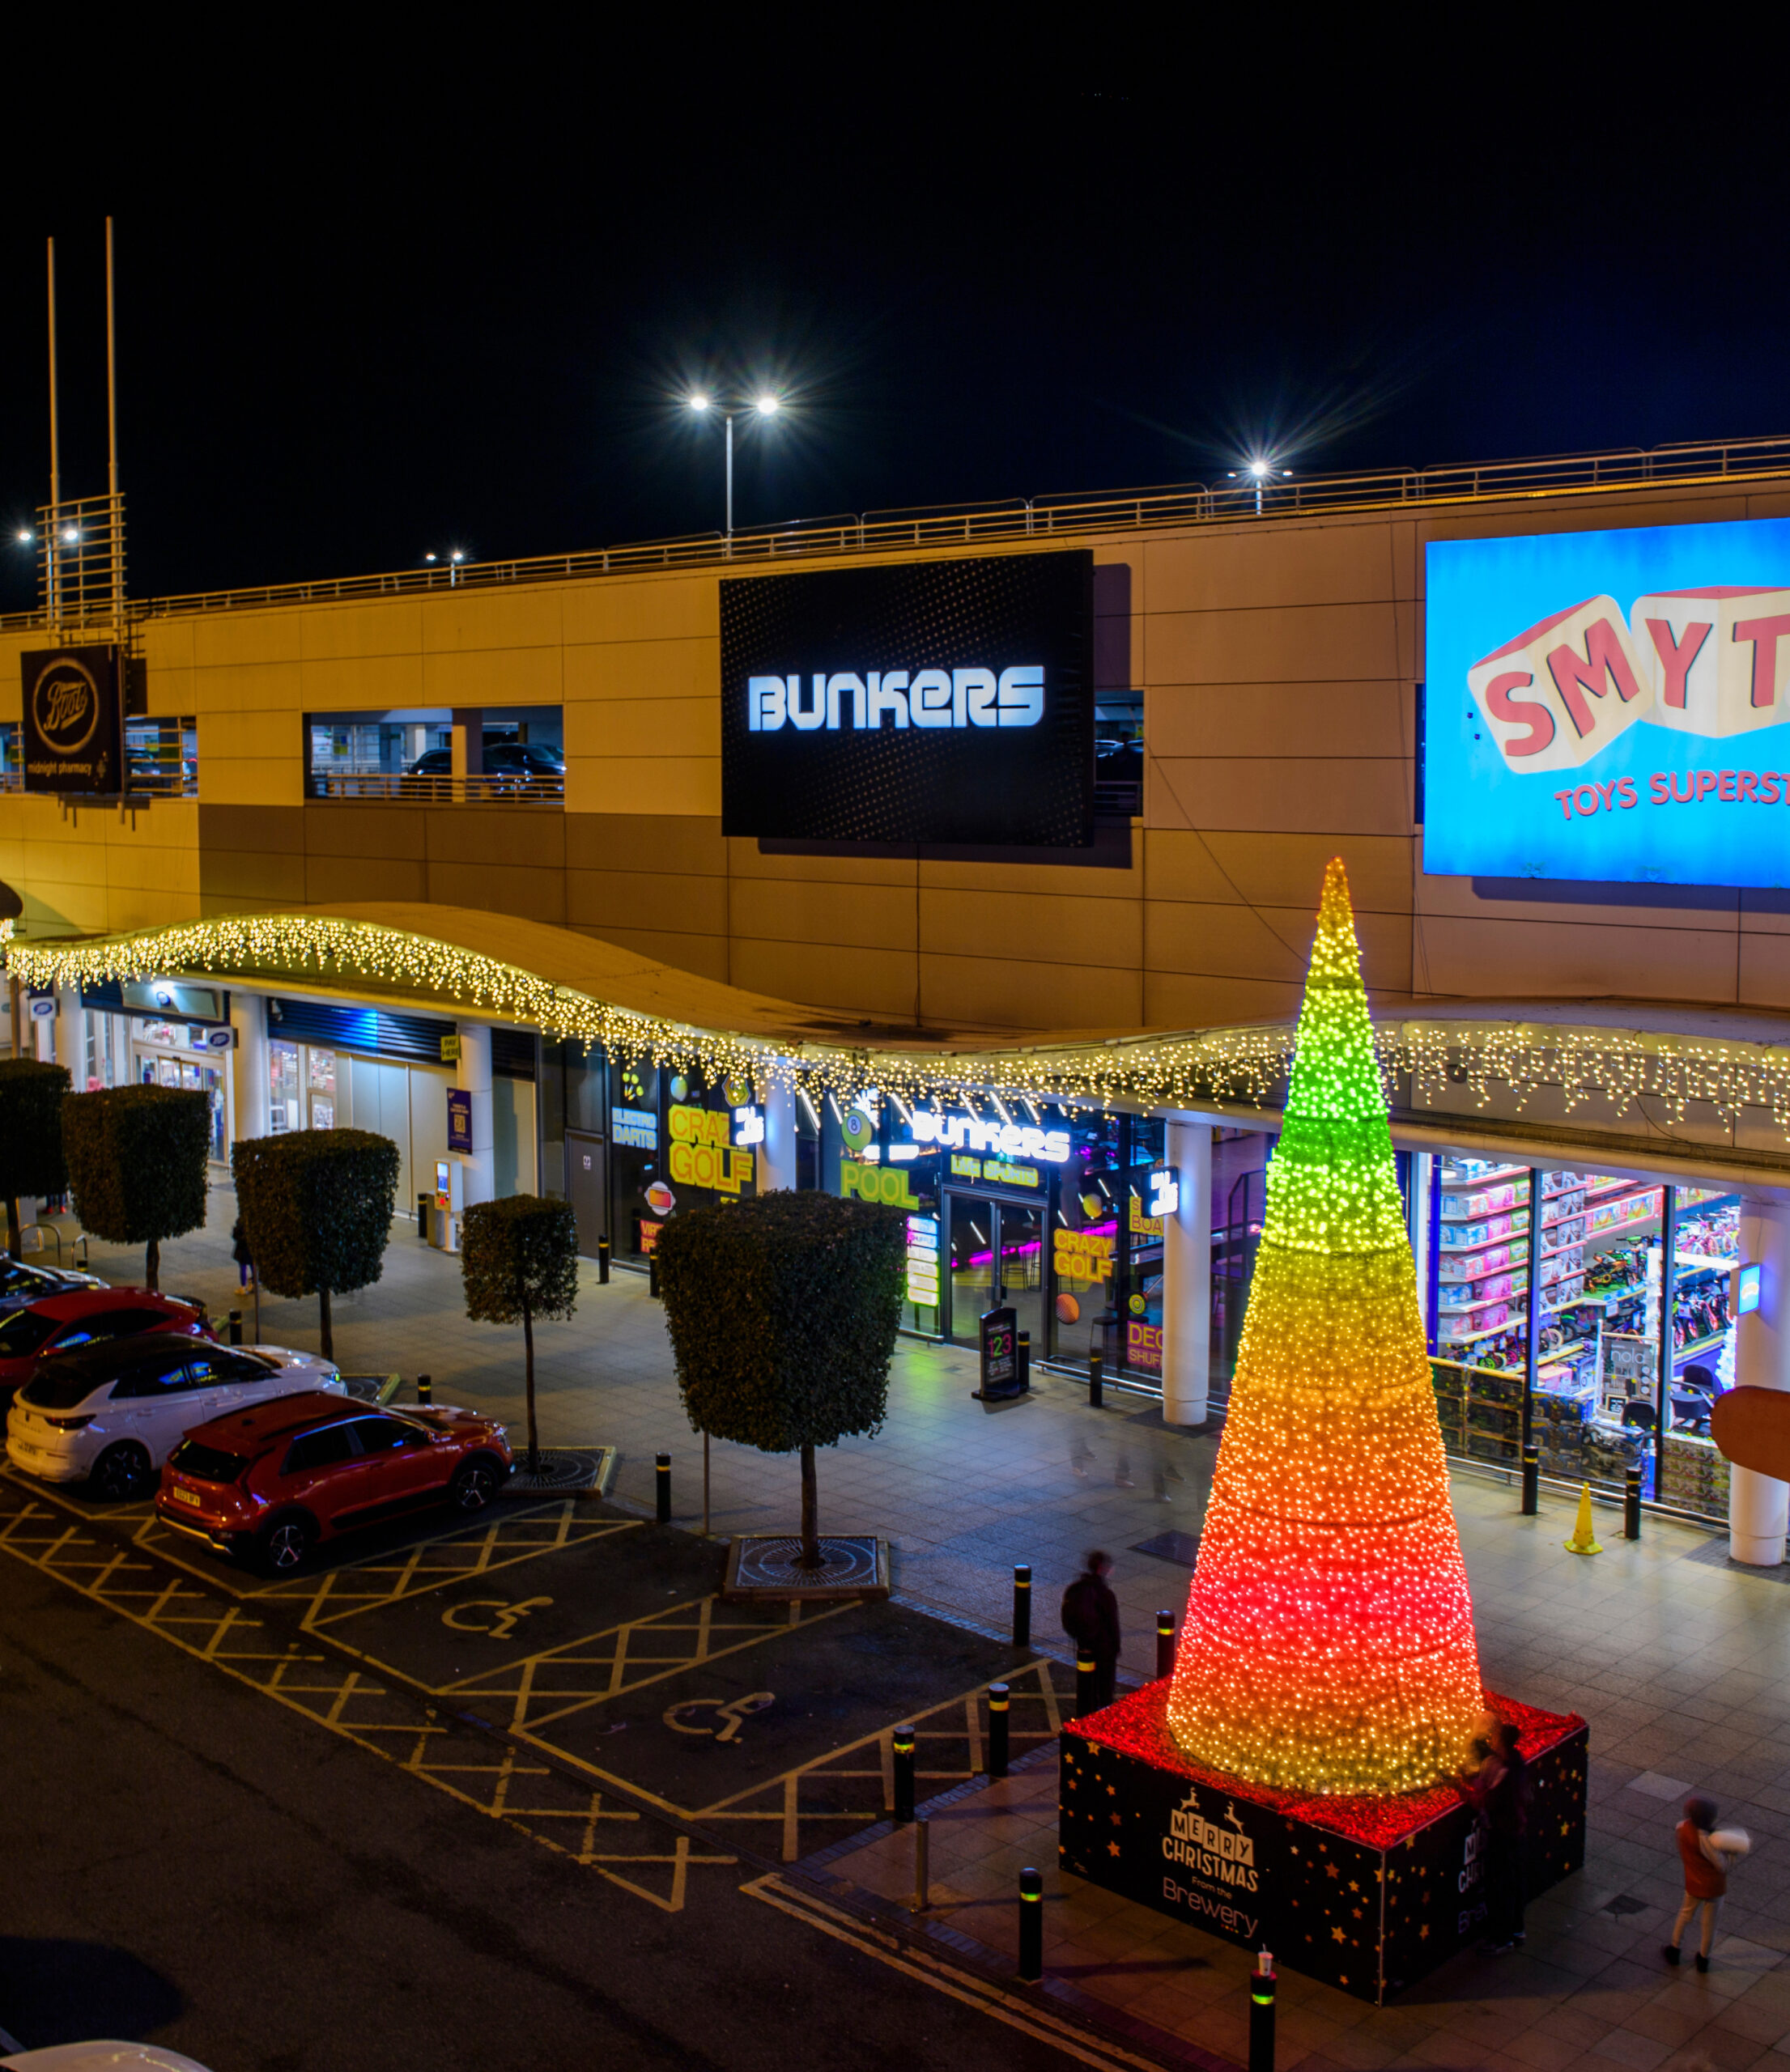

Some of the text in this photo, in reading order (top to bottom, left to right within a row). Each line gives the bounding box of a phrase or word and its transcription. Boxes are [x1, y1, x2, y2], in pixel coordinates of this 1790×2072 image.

[1485, 613, 1790, 758] SMYT
[43, 681, 88, 731] Boots
[28, 761, 91, 777] midnight pharmacy
[1554, 776, 1638, 820] TOYS
[442, 1048, 459, 1057] HERE
[444, 1038, 457, 1047] PAY
[613, 1109, 657, 1128] ELECTRO
[672, 1110, 729, 1145] CRAZ
[614, 1125, 657, 1149] DARTS
[673, 1144, 750, 1189] GOLF
[953, 1157, 1037, 1185] LIVE SPORTS
[844, 1165, 916, 1206] POOL
[1055, 1231, 1112, 1255] CRAZY
[1055, 1252, 1112, 1281] GOLF
[988, 1333, 1012, 1358] 123
[1610, 1347, 1645, 1364] nola
[1173, 1813, 1251, 1860] MERRY
[1162, 1836, 1259, 1892] CHRISTMAS
[1192, 1876, 1233, 1900] From the
[1163, 1877, 1258, 1938] Brewery
